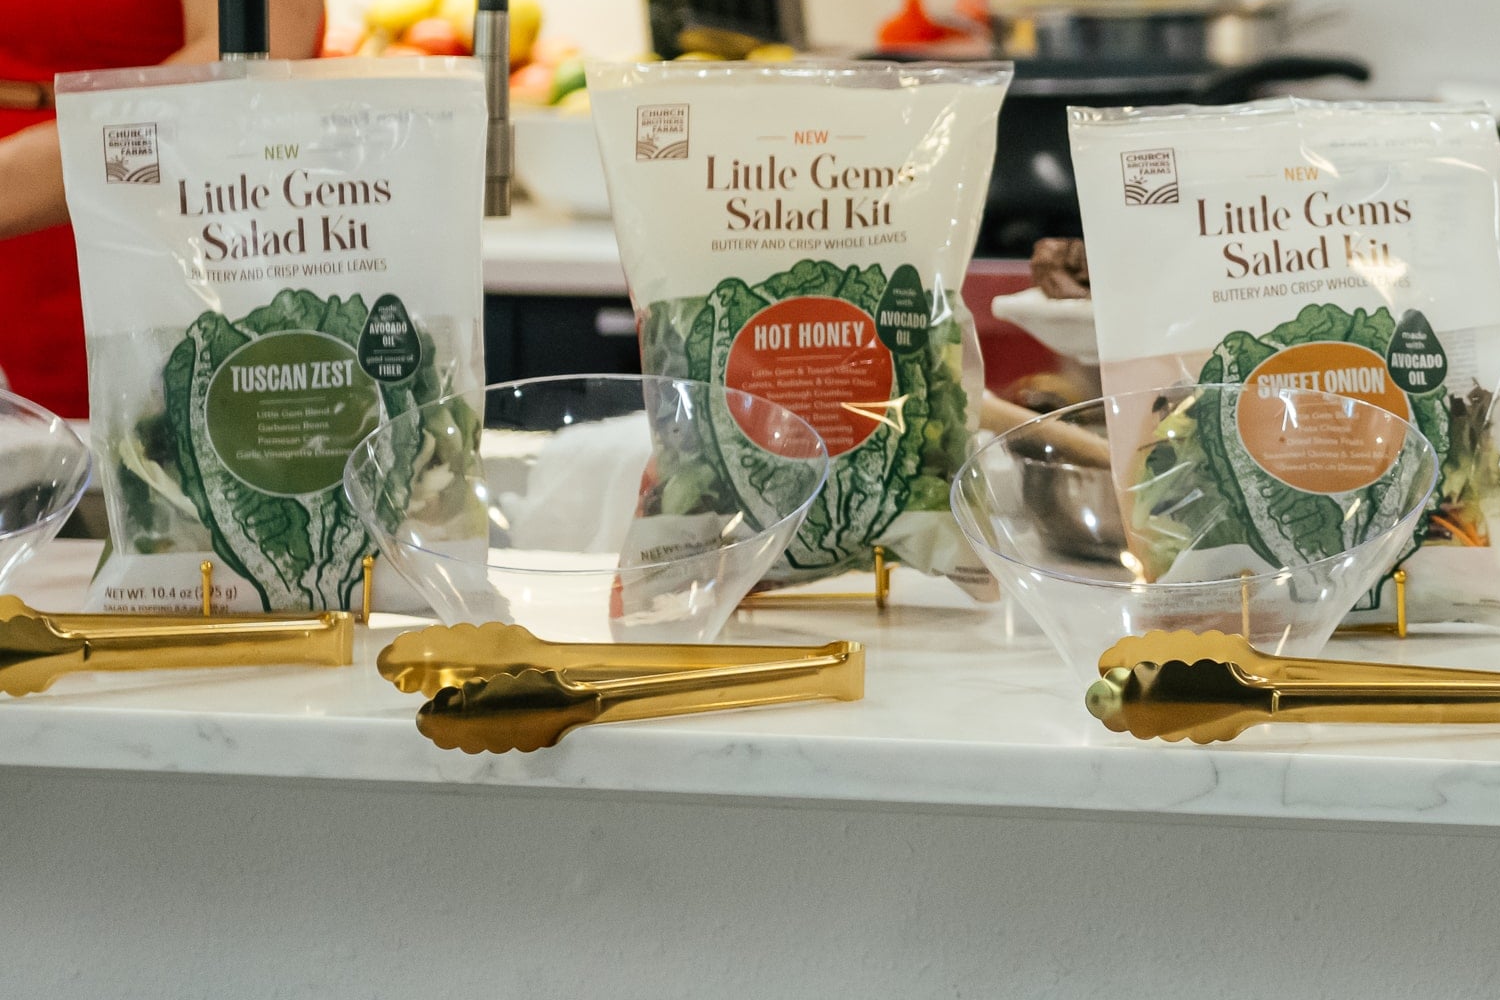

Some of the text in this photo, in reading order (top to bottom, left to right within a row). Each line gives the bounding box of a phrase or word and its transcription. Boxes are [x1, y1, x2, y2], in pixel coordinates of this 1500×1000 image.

[642, 108, 685, 118] CHURCH
[794, 130, 828, 144] NEW
[264, 144, 299, 160] NEW
[1126, 152, 1170, 162] CHURCH
[706, 154, 797, 191] Little
[1139, 167, 1171, 175] FARMS
[1284, 167, 1318, 181] NEW
[178, 168, 392, 216] Little Gems
[726, 197, 892, 231] Salad Kit
[1197, 191, 1412, 236] Little Gems
[202, 214, 371, 261] Salad Kit
[711, 232, 907, 251] BUTTERY AND CRISP WHOLE LEAVES
[1223, 235, 1330, 279] Salad
[240, 258, 387, 281] AND CRISP WHOLE LEAVES
[1213, 277, 1367, 303] BUTTERY AND CRISP WHOLE
[880, 311, 927, 328] AVOCADO
[369, 321, 408, 335] AVOCADO
[754, 321, 865, 350] HOT HONEY
[1402, 331, 1427, 340] made
[382, 334, 395, 347] OIL
[896, 330, 911, 345] OIL
[1405, 341, 1424, 349] with
[1391, 354, 1443, 369] AVOCADO
[230, 359, 354, 393] TUSCAN ZEST
[379, 363, 402, 376] FIBER
[1257, 366, 1385, 399] SWEET ONION
[1408, 371, 1427, 386] OIL
[104, 586, 123, 599] NET
[152, 585, 176, 600] 10.4
[179, 590, 192, 599] oz
